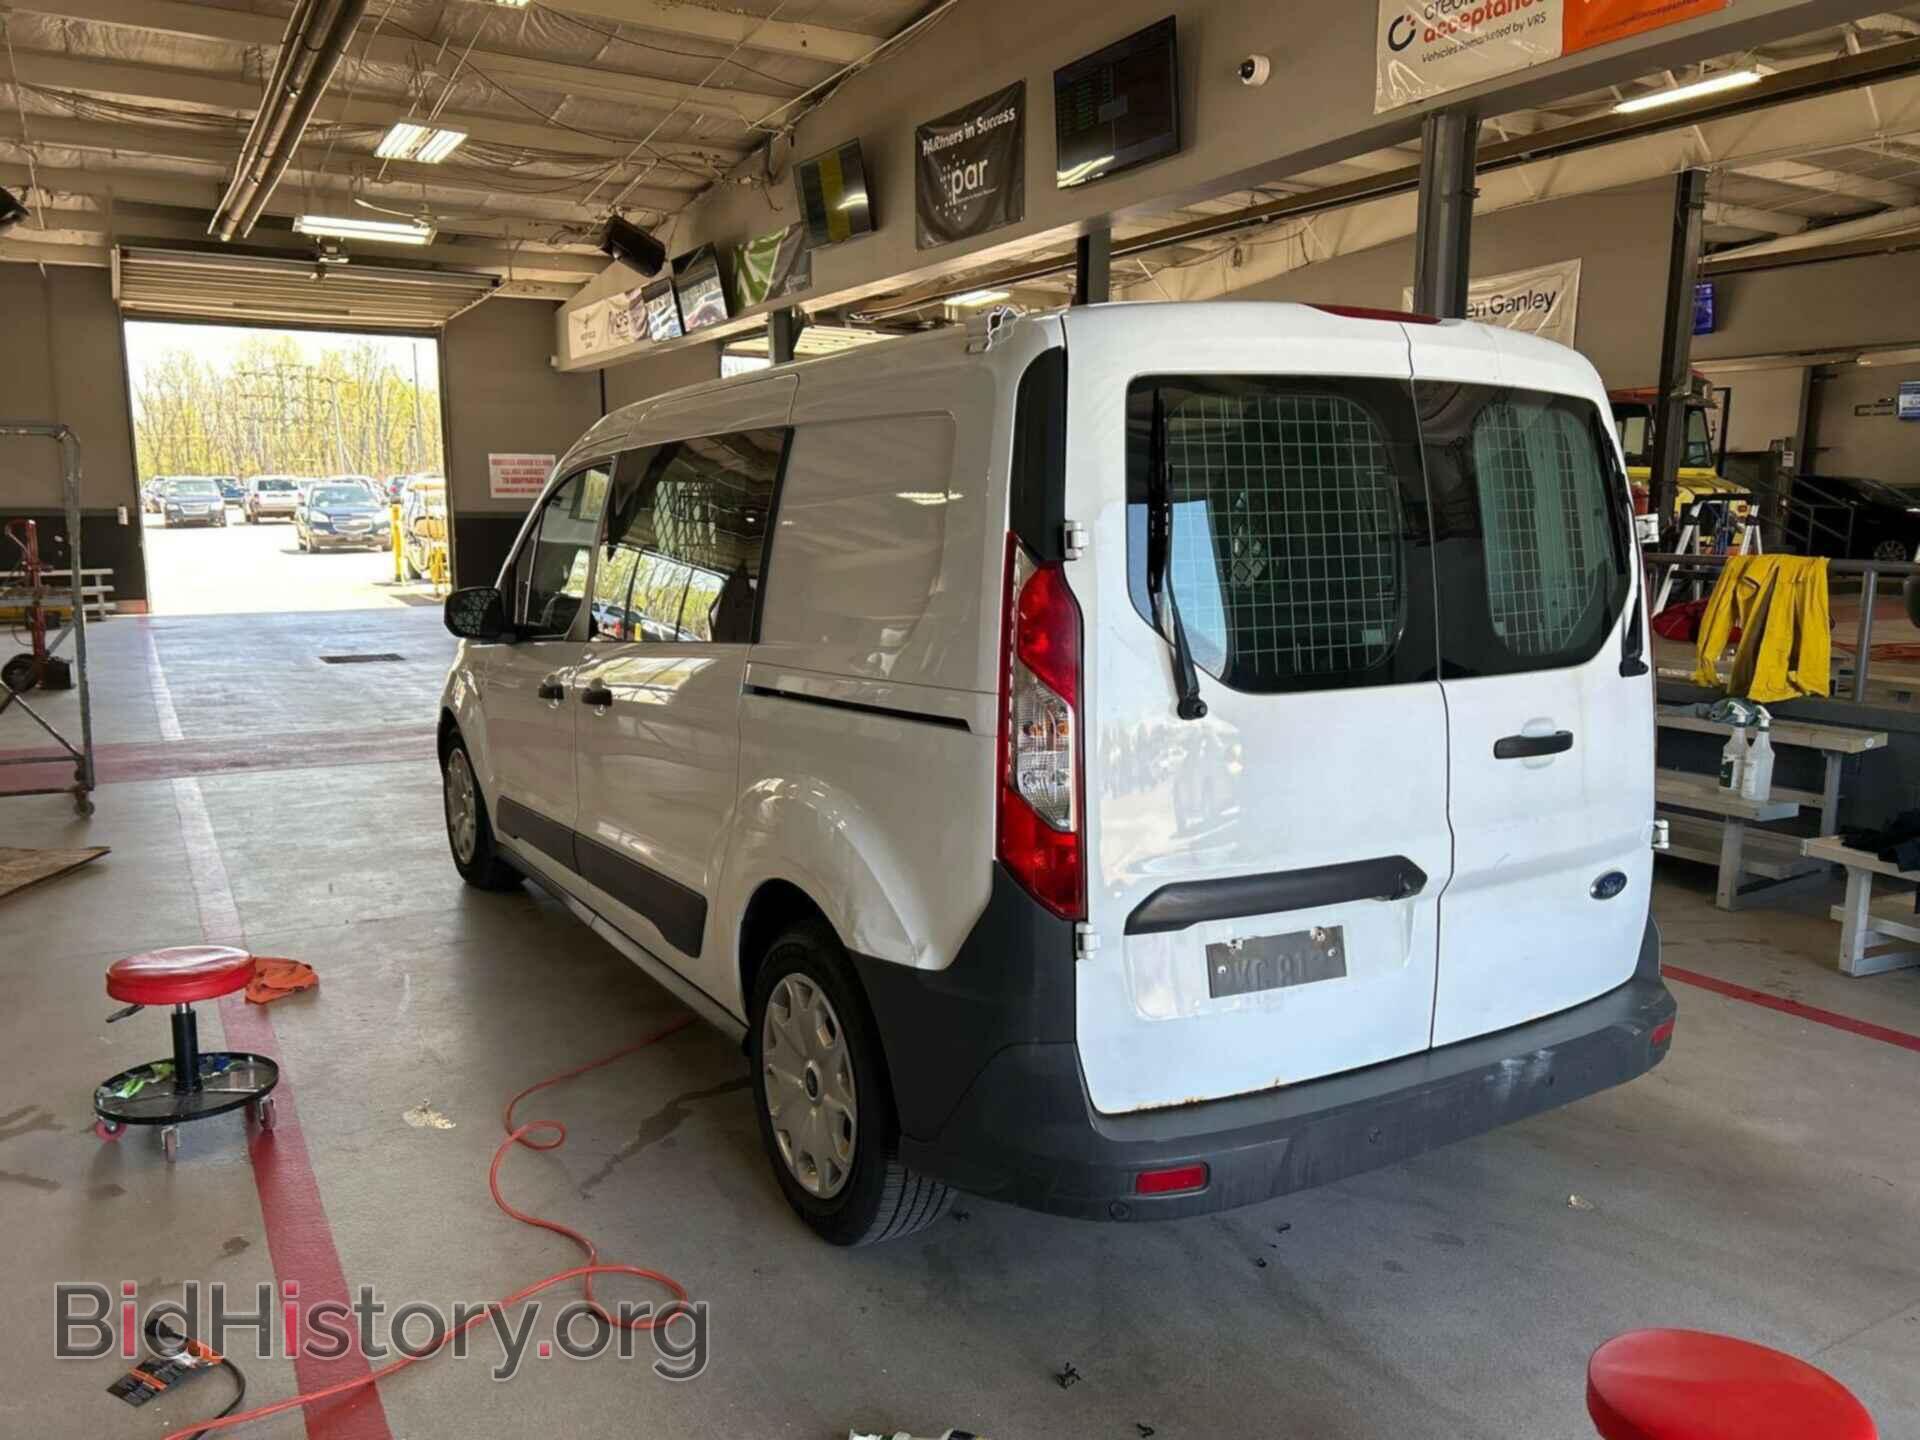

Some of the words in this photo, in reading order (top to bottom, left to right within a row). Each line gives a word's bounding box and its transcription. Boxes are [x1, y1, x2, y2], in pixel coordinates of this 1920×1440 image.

[1513, 20, 1525, 32] by
[1527, 12, 1546, 27] VRS
[964, 122, 975, 139] in
[976, 107, 1016, 134] Success
[952, 160, 988, 205] par
[1466, 303, 1486, 318] en
[1490, 289, 1556, 315] Ganley
